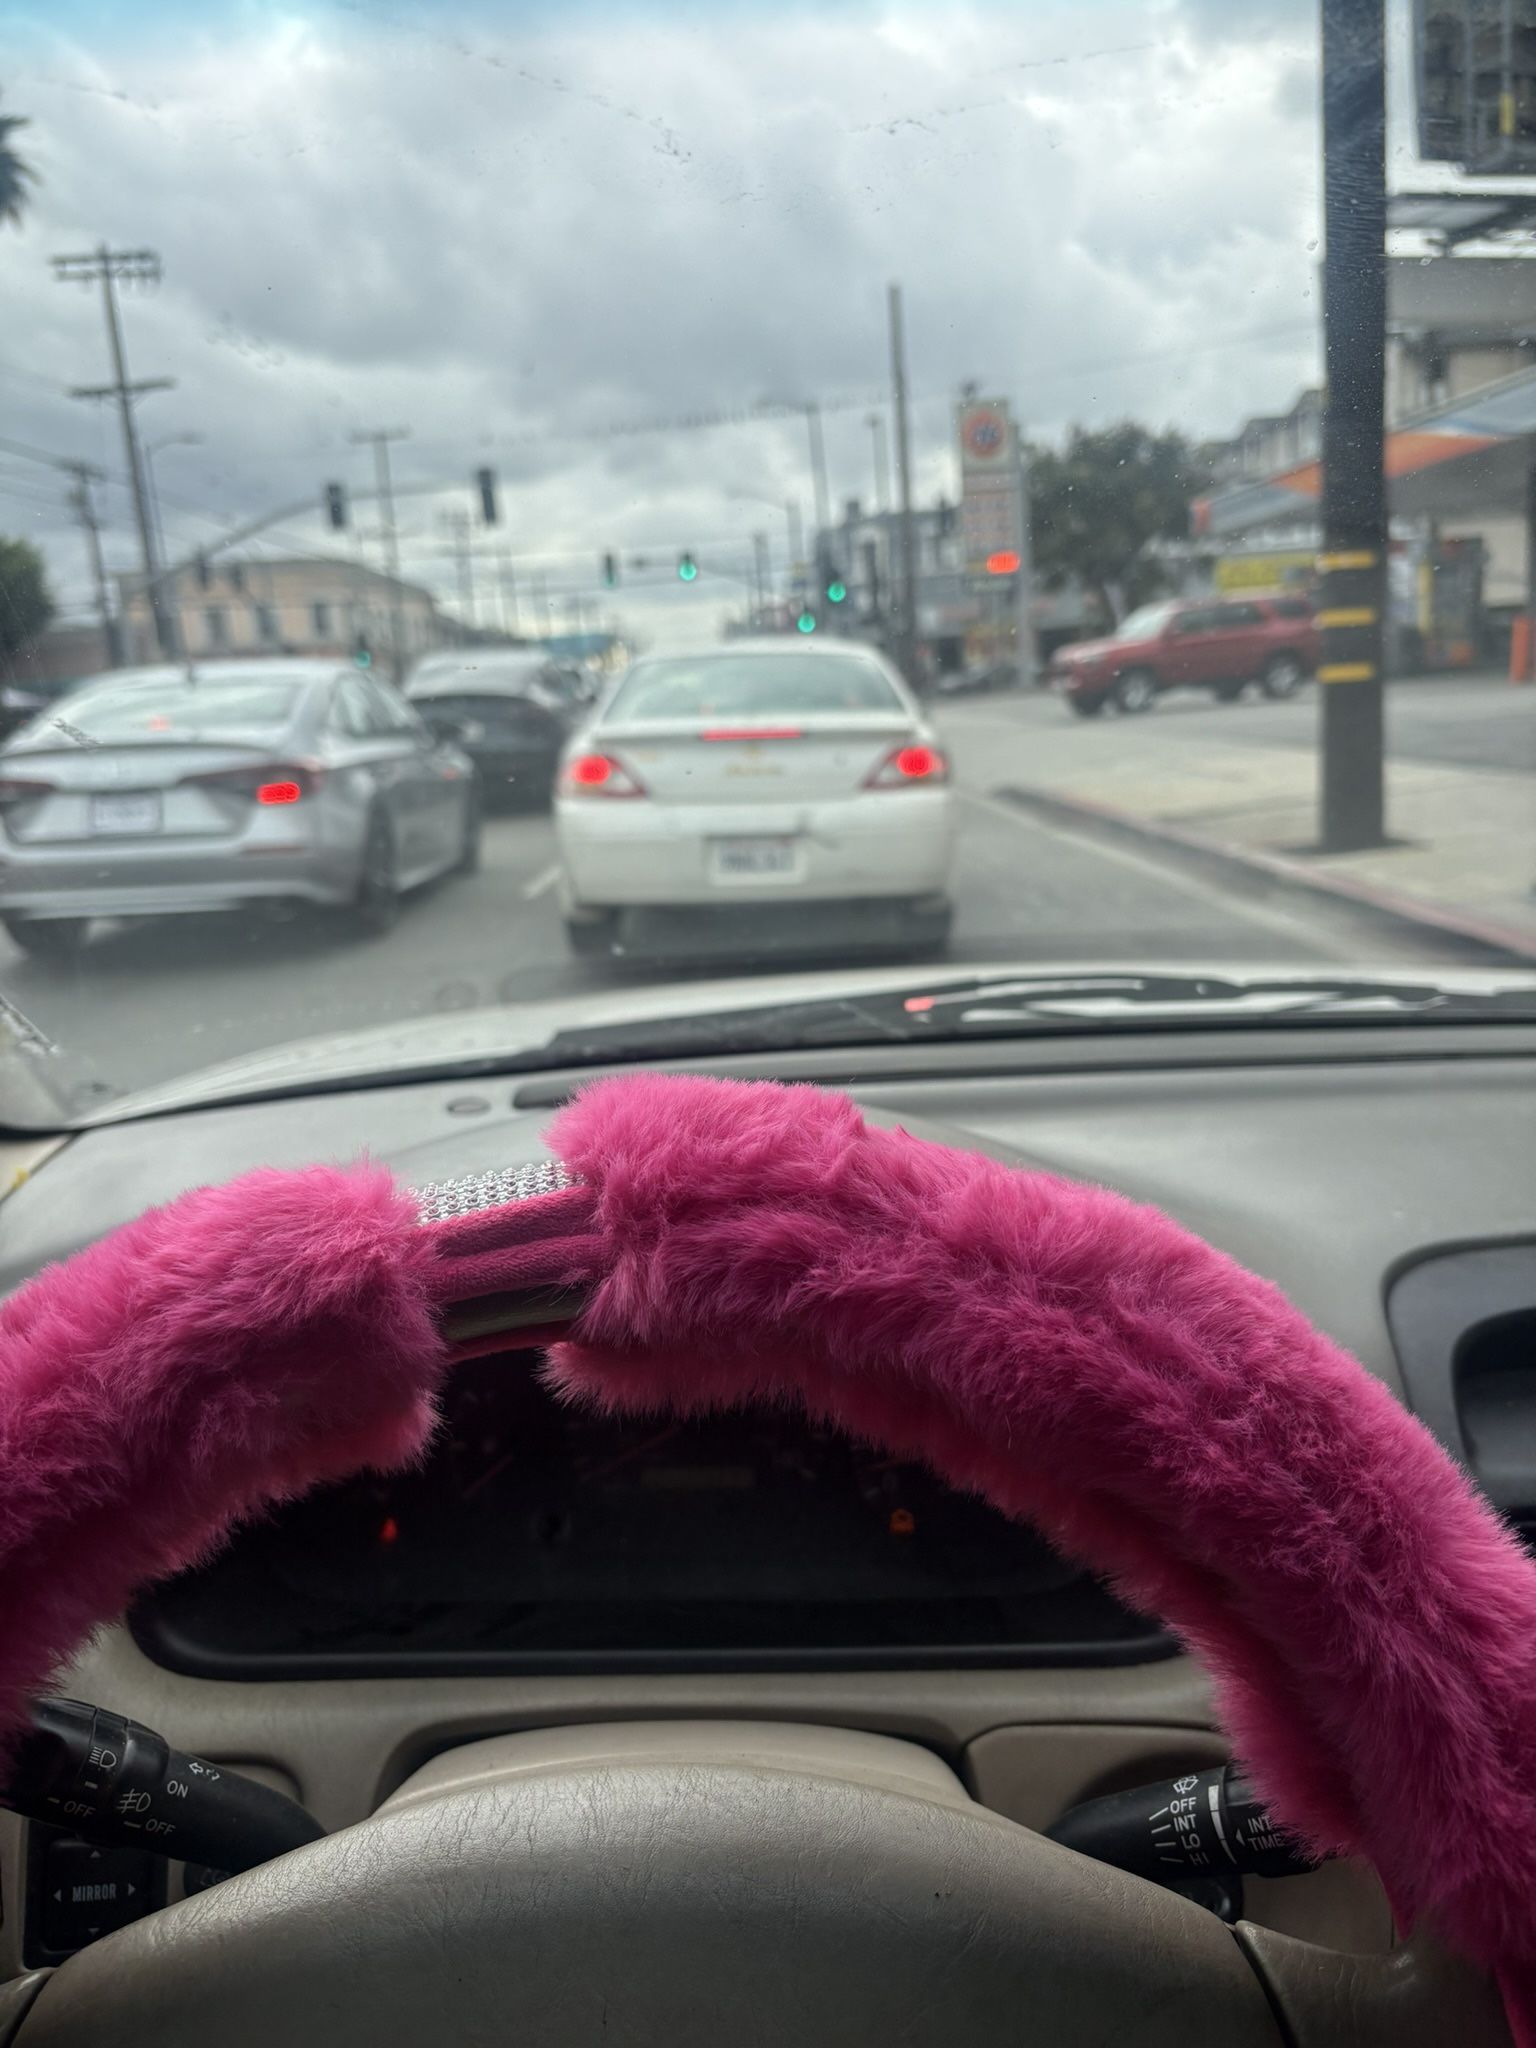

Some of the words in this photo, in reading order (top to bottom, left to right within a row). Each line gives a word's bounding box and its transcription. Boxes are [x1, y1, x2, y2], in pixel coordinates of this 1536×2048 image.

[167, 1780, 188, 1798] ON
[64, 1800, 96, 1818] OFF
[1170, 1797, 1197, 1814] OFF
[145, 1818, 177, 1836] OFF
[1174, 1814, 1197, 1832] INT
[1248, 1815, 1273, 1834] INT
[1181, 1833, 1201, 1849] LO
[1247, 1833, 1285, 1852] TIME
[1188, 1852, 1210, 1866] HI
[72, 1884, 117, 1902] MIRROR
